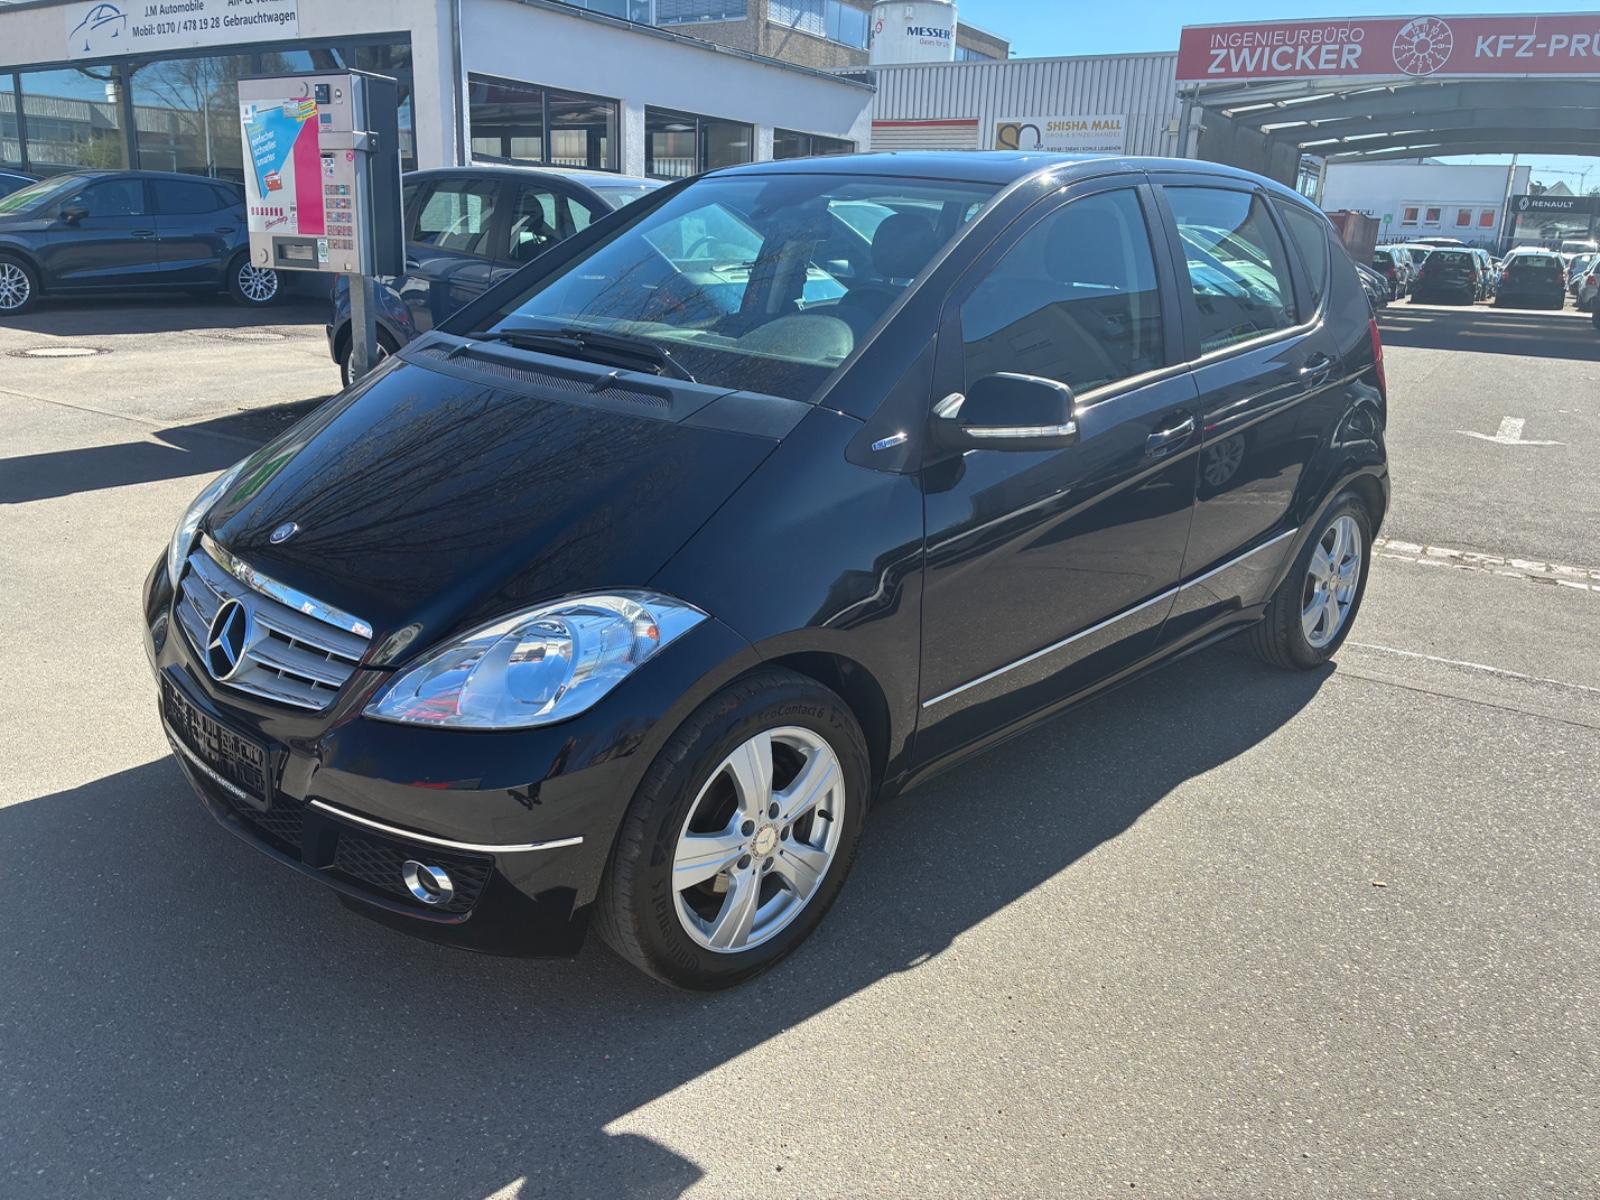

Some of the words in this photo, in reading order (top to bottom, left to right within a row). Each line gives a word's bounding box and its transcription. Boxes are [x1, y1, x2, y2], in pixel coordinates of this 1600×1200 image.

[160, 0, 204, 15] Automobile
[132, 24, 155, 37] Mobil:
[156, 22, 175, 35] 0170
[177, 20, 181, 34] /
[183, 19, 197, 32] 478
[199, 18, 208, 30] 19
[210, 16, 221, 29] 28
[223, 11, 296, 27] Gebrauchtwagen
[906, 26, 950, 40] MESSER
[1210, 27, 1365, 49] INGENIEURBÜRO
[1207, 44, 1362, 74] ZWICKER
[1046, 121, 1088, 132] SHISHA
[1091, 119, 1122, 131] MALL
[1531, 200, 1574, 208] RENAULT
